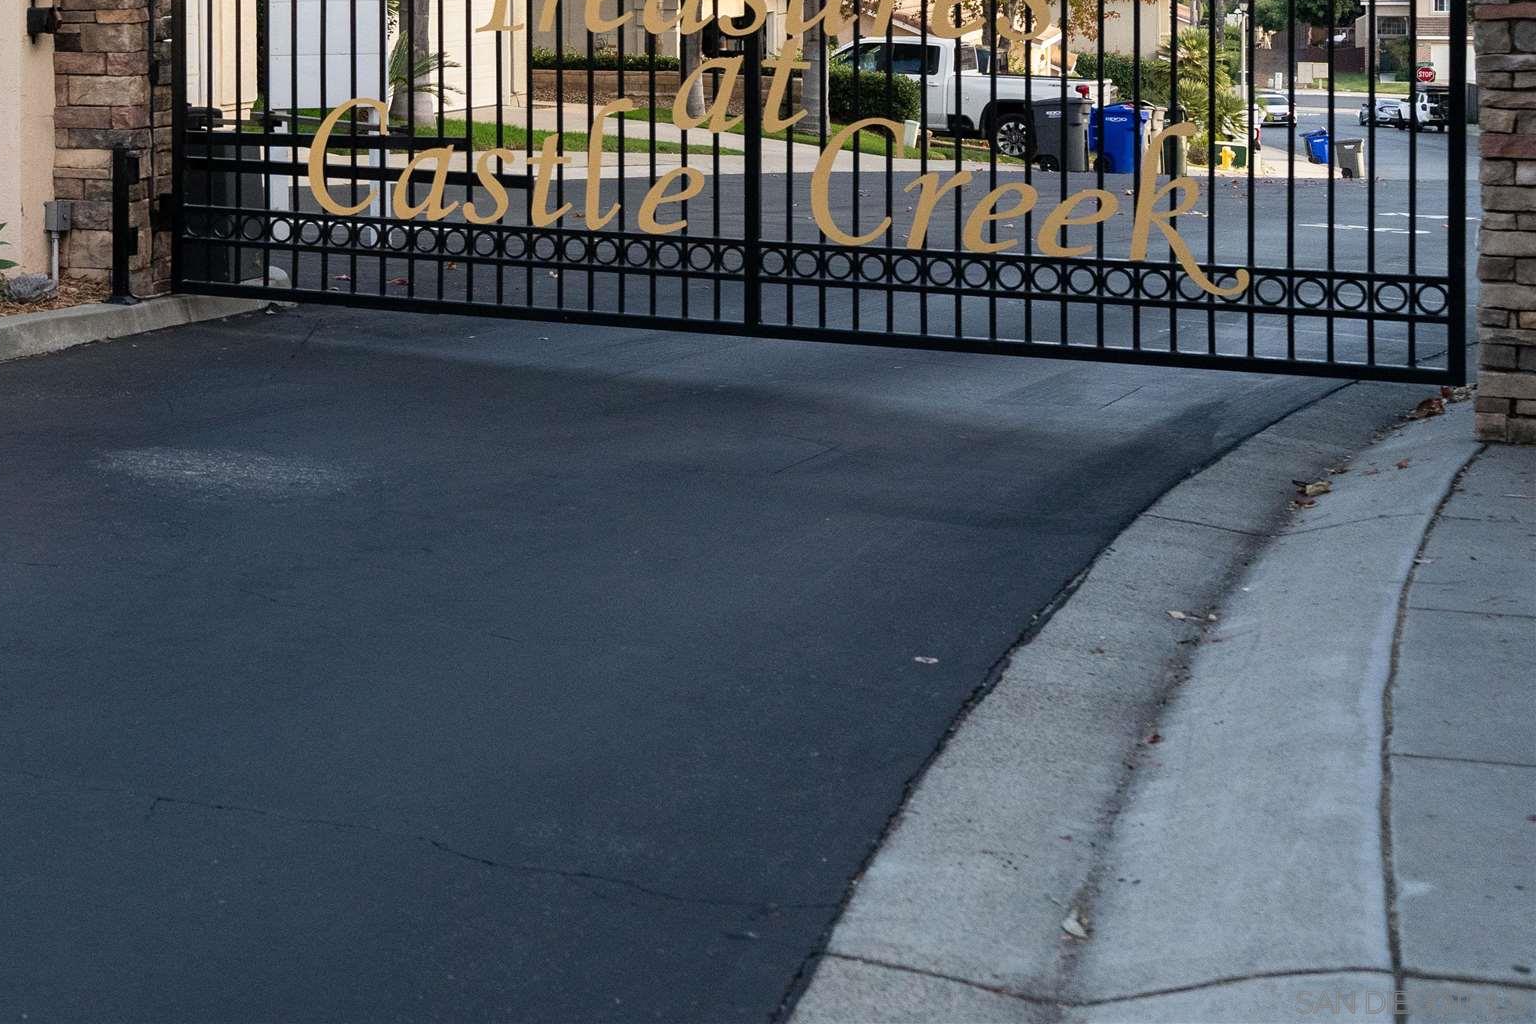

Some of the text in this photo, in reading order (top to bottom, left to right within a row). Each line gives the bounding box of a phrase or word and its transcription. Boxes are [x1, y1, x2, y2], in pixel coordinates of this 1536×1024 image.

[672, 37, 811, 134] at
[1418, 70, 1433, 78] STOP
[307, 97, 1250, 297] Castle Creek
